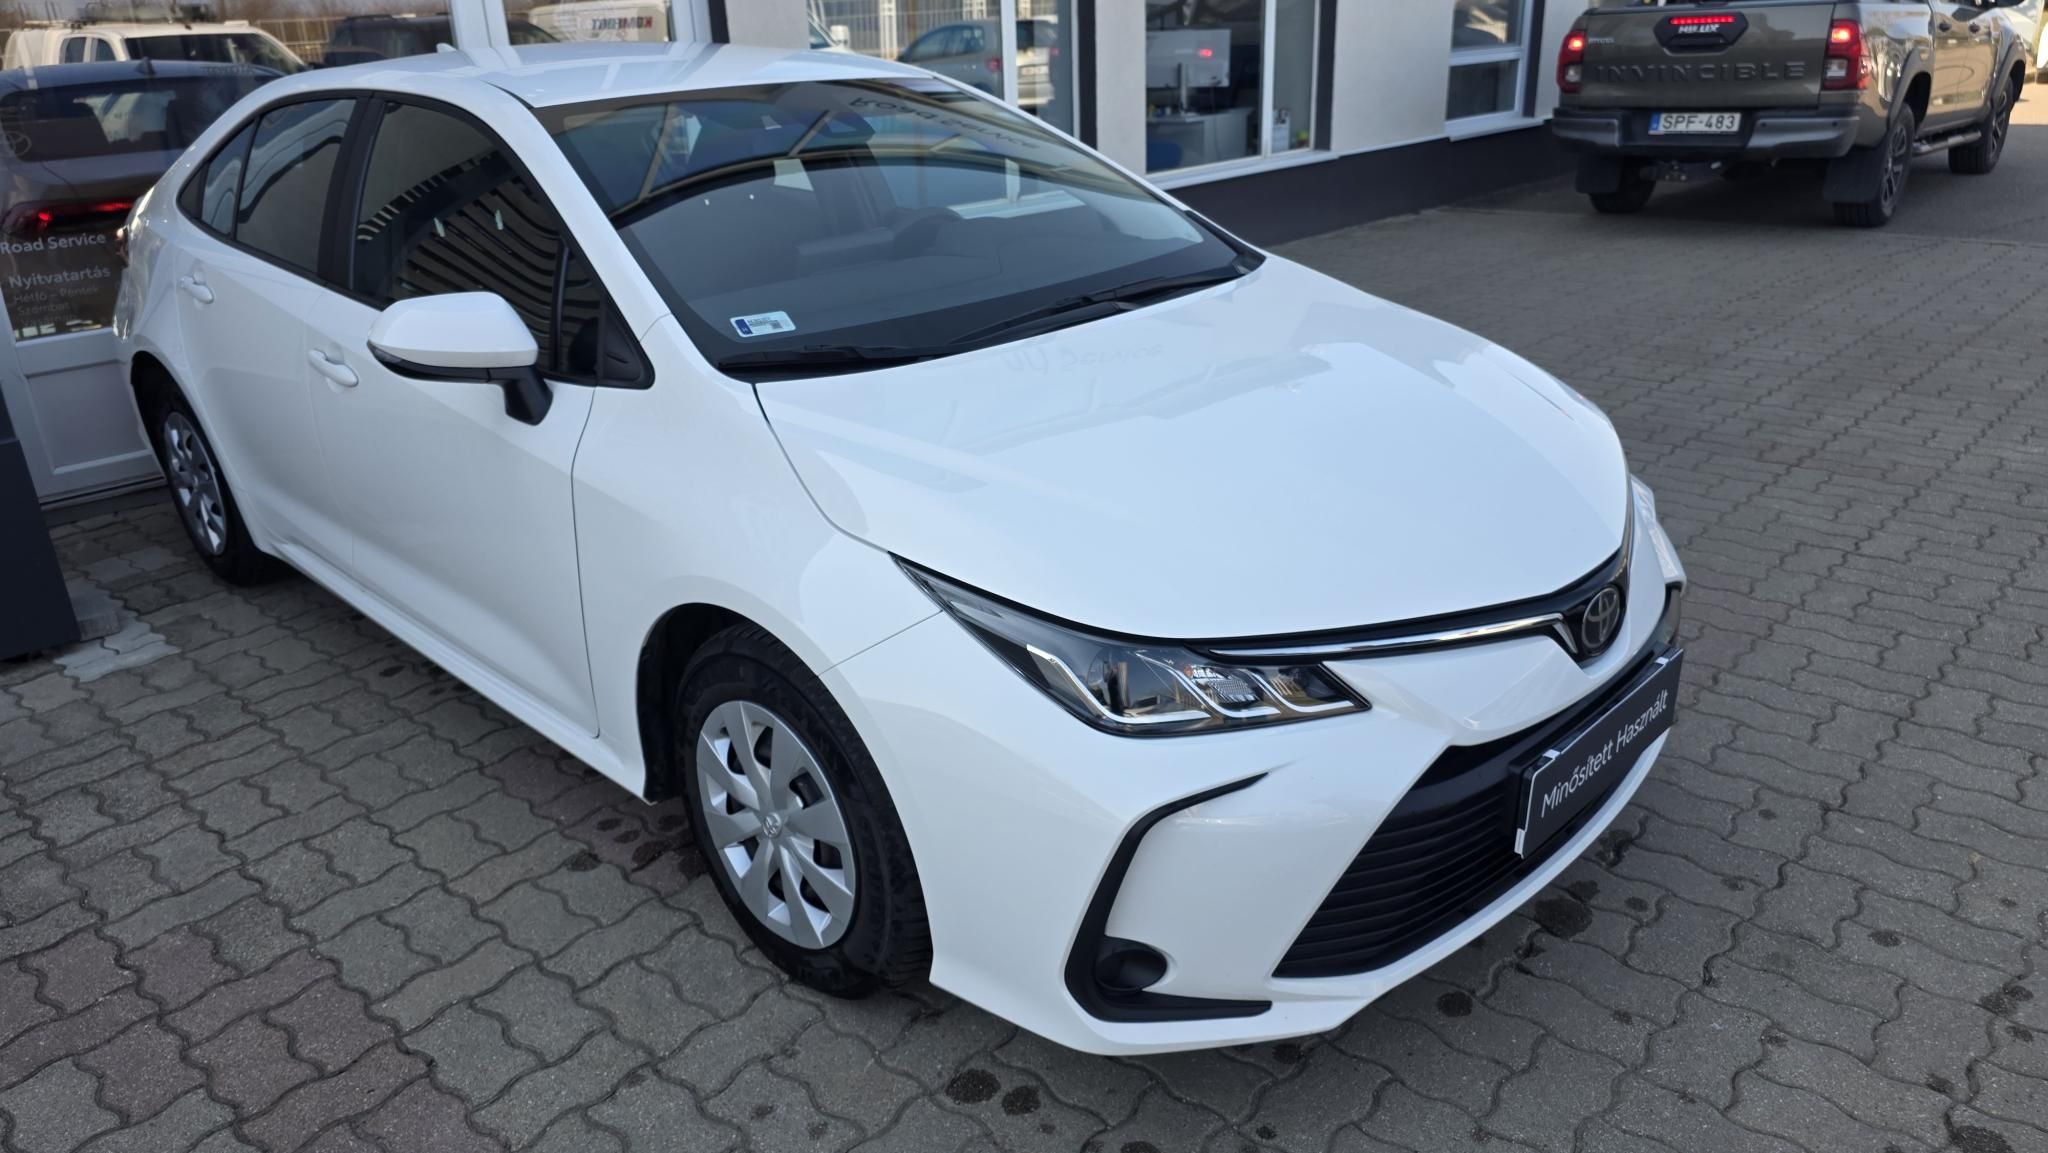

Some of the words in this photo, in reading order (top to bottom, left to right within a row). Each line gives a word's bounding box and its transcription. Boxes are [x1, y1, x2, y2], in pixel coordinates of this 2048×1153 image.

[1678, 24, 1720, 34] HILUX
[1596, 61, 1806, 81] INVINCIBLE
[1662, 115, 1736, 130] SPF-483
[0, 238, 44, 254] Road
[47, 233, 107, 249] Service
[8, 265, 112, 290] Nyitvatartás
[1541, 739, 1614, 818] Minősített
[1616, 688, 1668, 752] Használt
